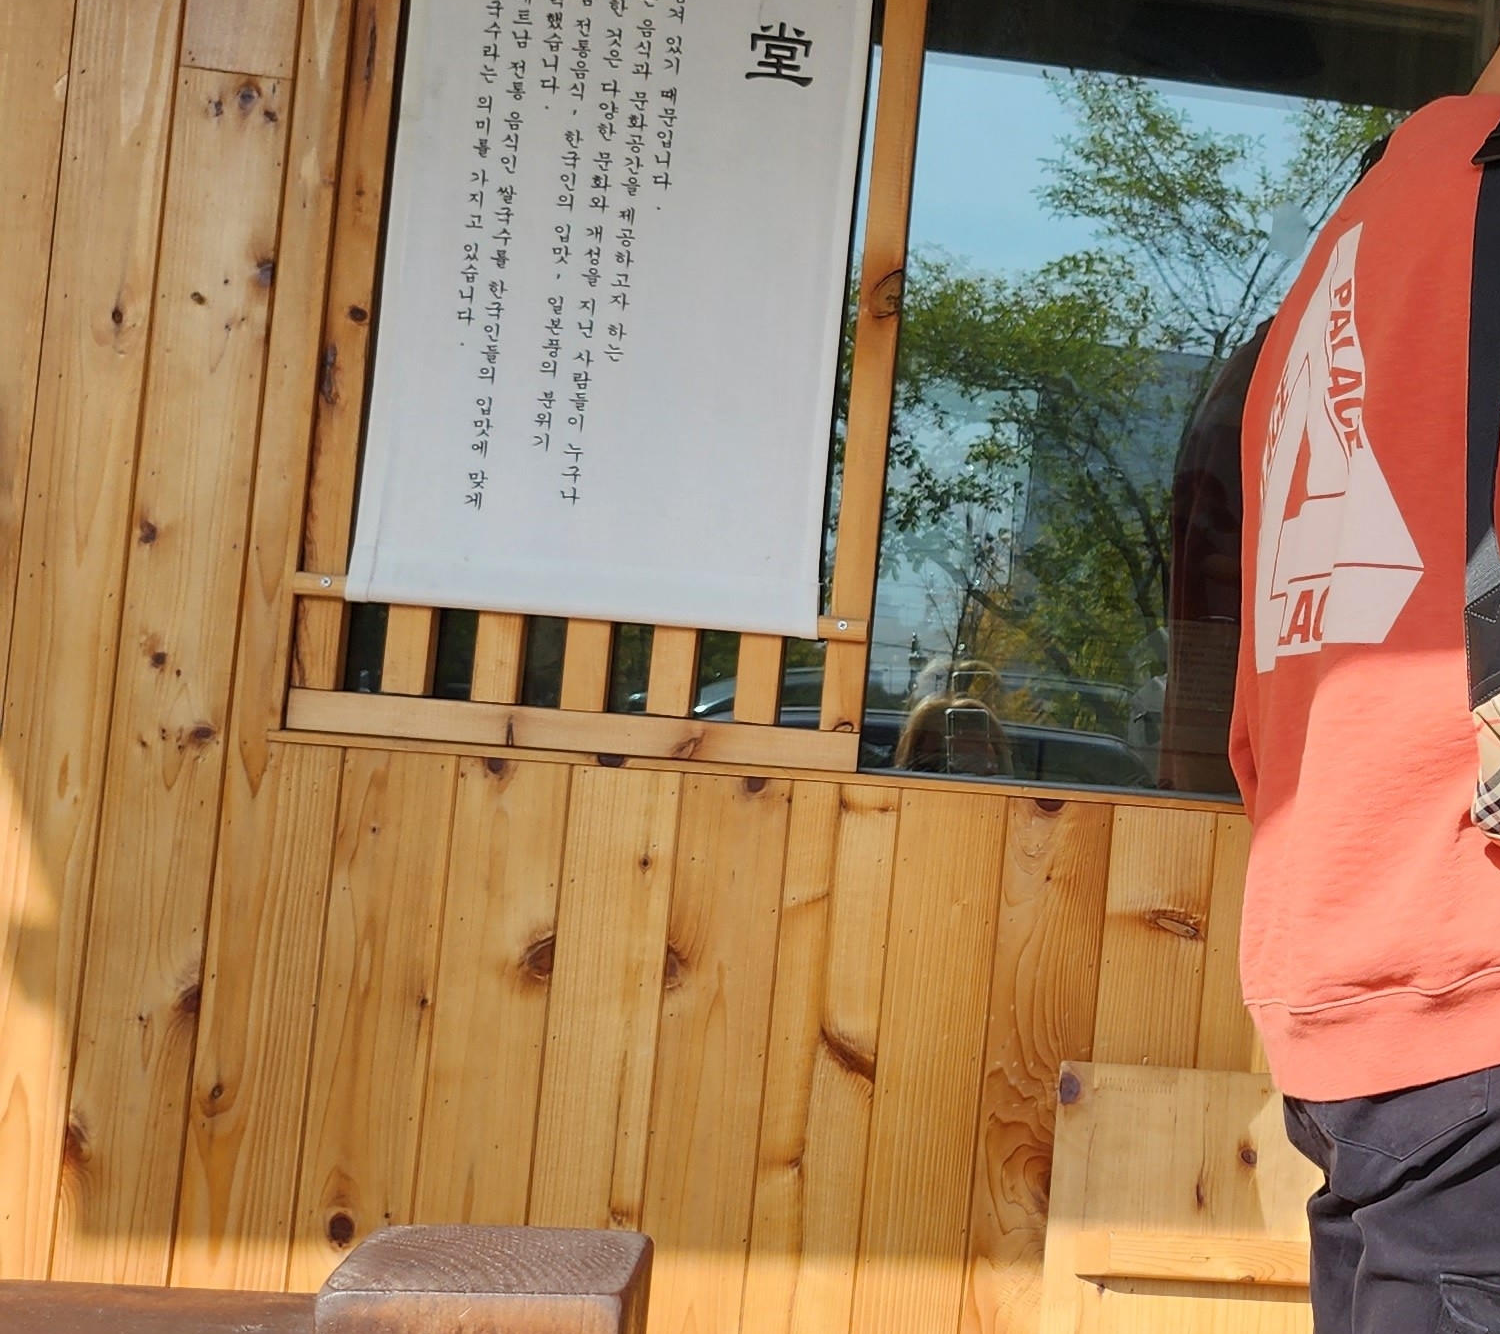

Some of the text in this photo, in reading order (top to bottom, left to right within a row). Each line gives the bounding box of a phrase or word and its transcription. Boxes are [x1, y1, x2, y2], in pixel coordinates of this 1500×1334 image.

[602, 27, 623, 69] 것은
[631, 18, 657, 81] 음식과
[663, 35, 683, 76] 있기
[506, 59, 526, 101] 전통
[596, 79, 621, 142] 다양한
[472, 95, 493, 159] 의미를
[500, 111, 524, 175] 음식인
[620, 91, 649, 197] 문화공간을
[652, 86, 678, 211] 때문입니다.
[465, 168, 489, 229] 가지고
[556, 129, 584, 212] 한국인의
[588, 151, 613, 214] 문화와
[489, 184, 518, 270] 쌀국수를
[580, 225, 604, 288] 개성을
[609, 206, 636, 312] 제공하고자
[456, 242, 479, 347] 있습니다.
[577, 297, 596, 339] 지닌
[477, 279, 509, 385] 한국인들의
[539, 295, 564, 379] 일본풍의
[603, 322, 628, 363] 하는
[567, 349, 595, 433] 사람들이
[1327, 278, 1365, 458] PALACE
[471, 396, 494, 459] 입맛에
[532, 390, 557, 452] 분위기
[463, 469, 489, 511] 맞게
[559, 442, 584, 506] 누구나
